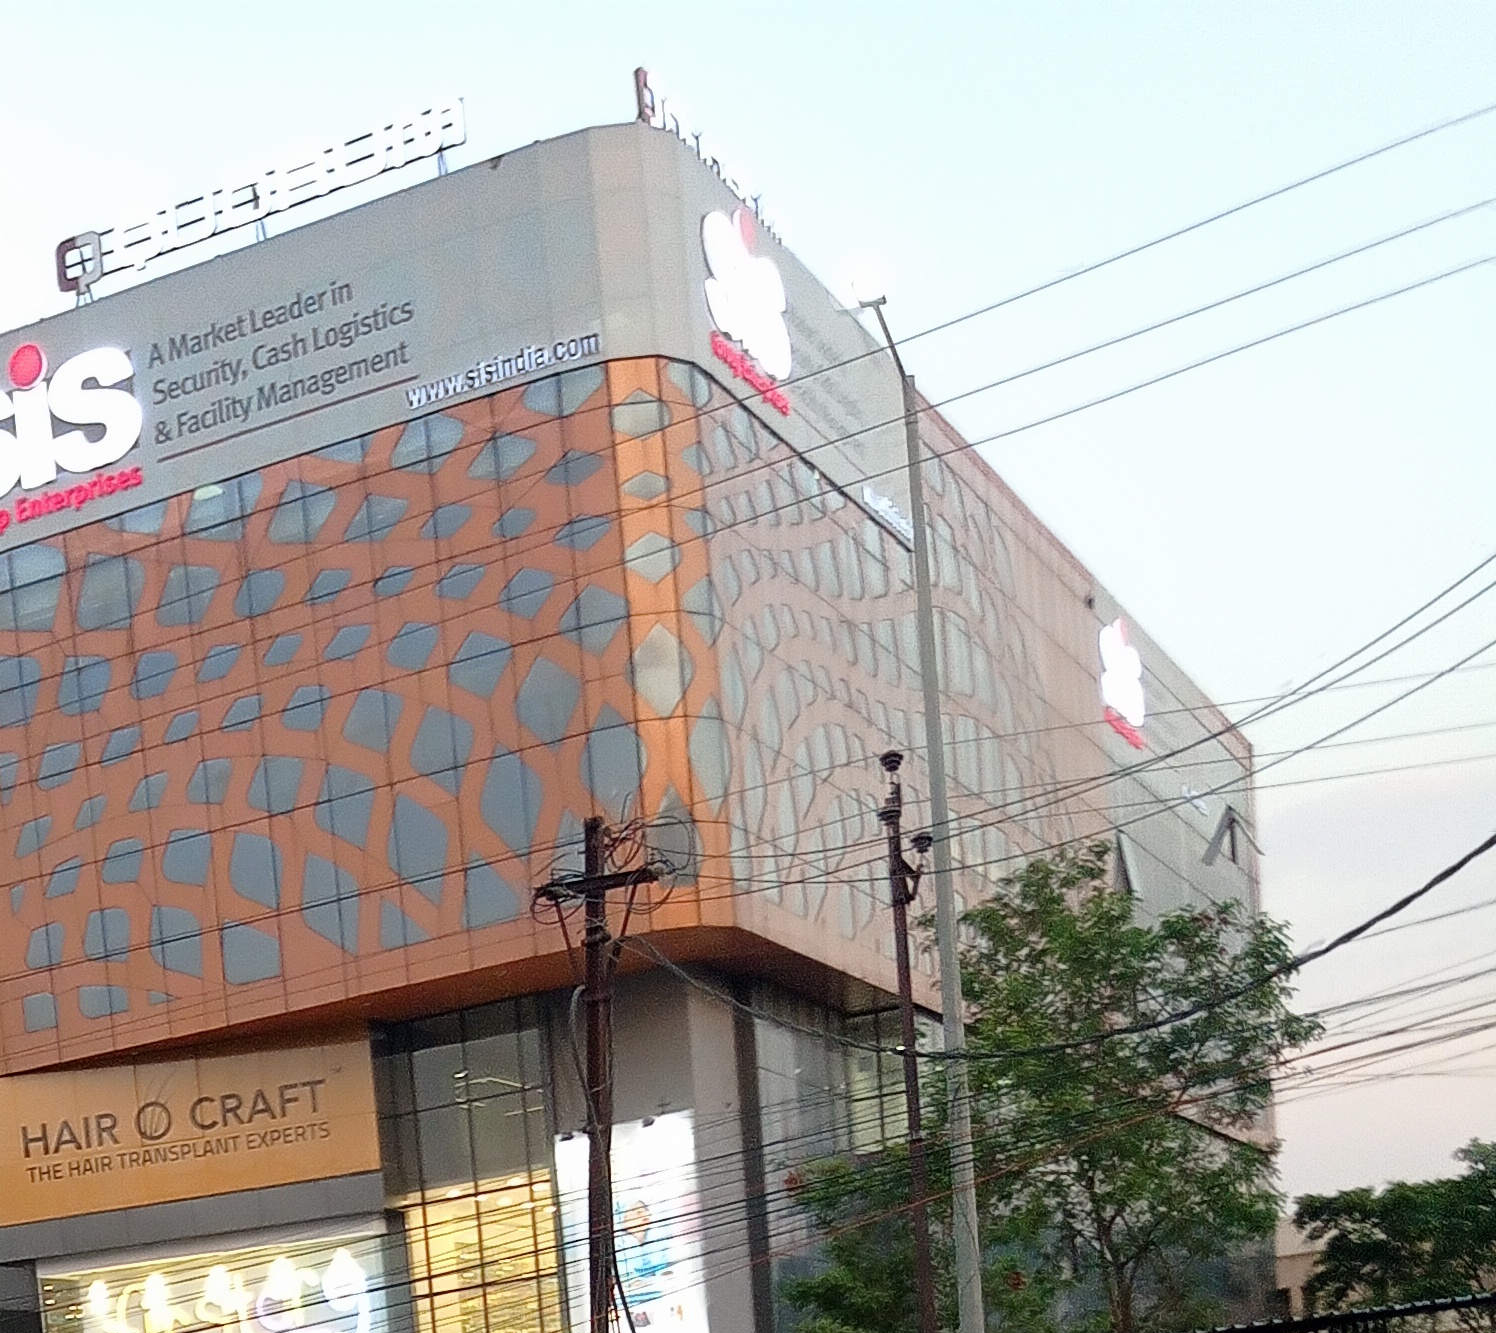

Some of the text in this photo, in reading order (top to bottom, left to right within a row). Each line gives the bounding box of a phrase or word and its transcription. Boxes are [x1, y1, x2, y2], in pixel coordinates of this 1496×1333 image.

[148, 280, 354, 368] A Market Leader in
[153, 300, 414, 405] Security, Cash Logistics
[155, 340, 411, 444] & Facility Management
[406, 332, 601, 410] www.sisindia.com
[14, 466, 144, 523] Enterprises
[21, 1112, 121, 1159] HAIR
[189, 1078, 326, 1131] CRAFT
[26, 1121, 331, 1184] THE HAIR TRANSPLANT EXPERTS
